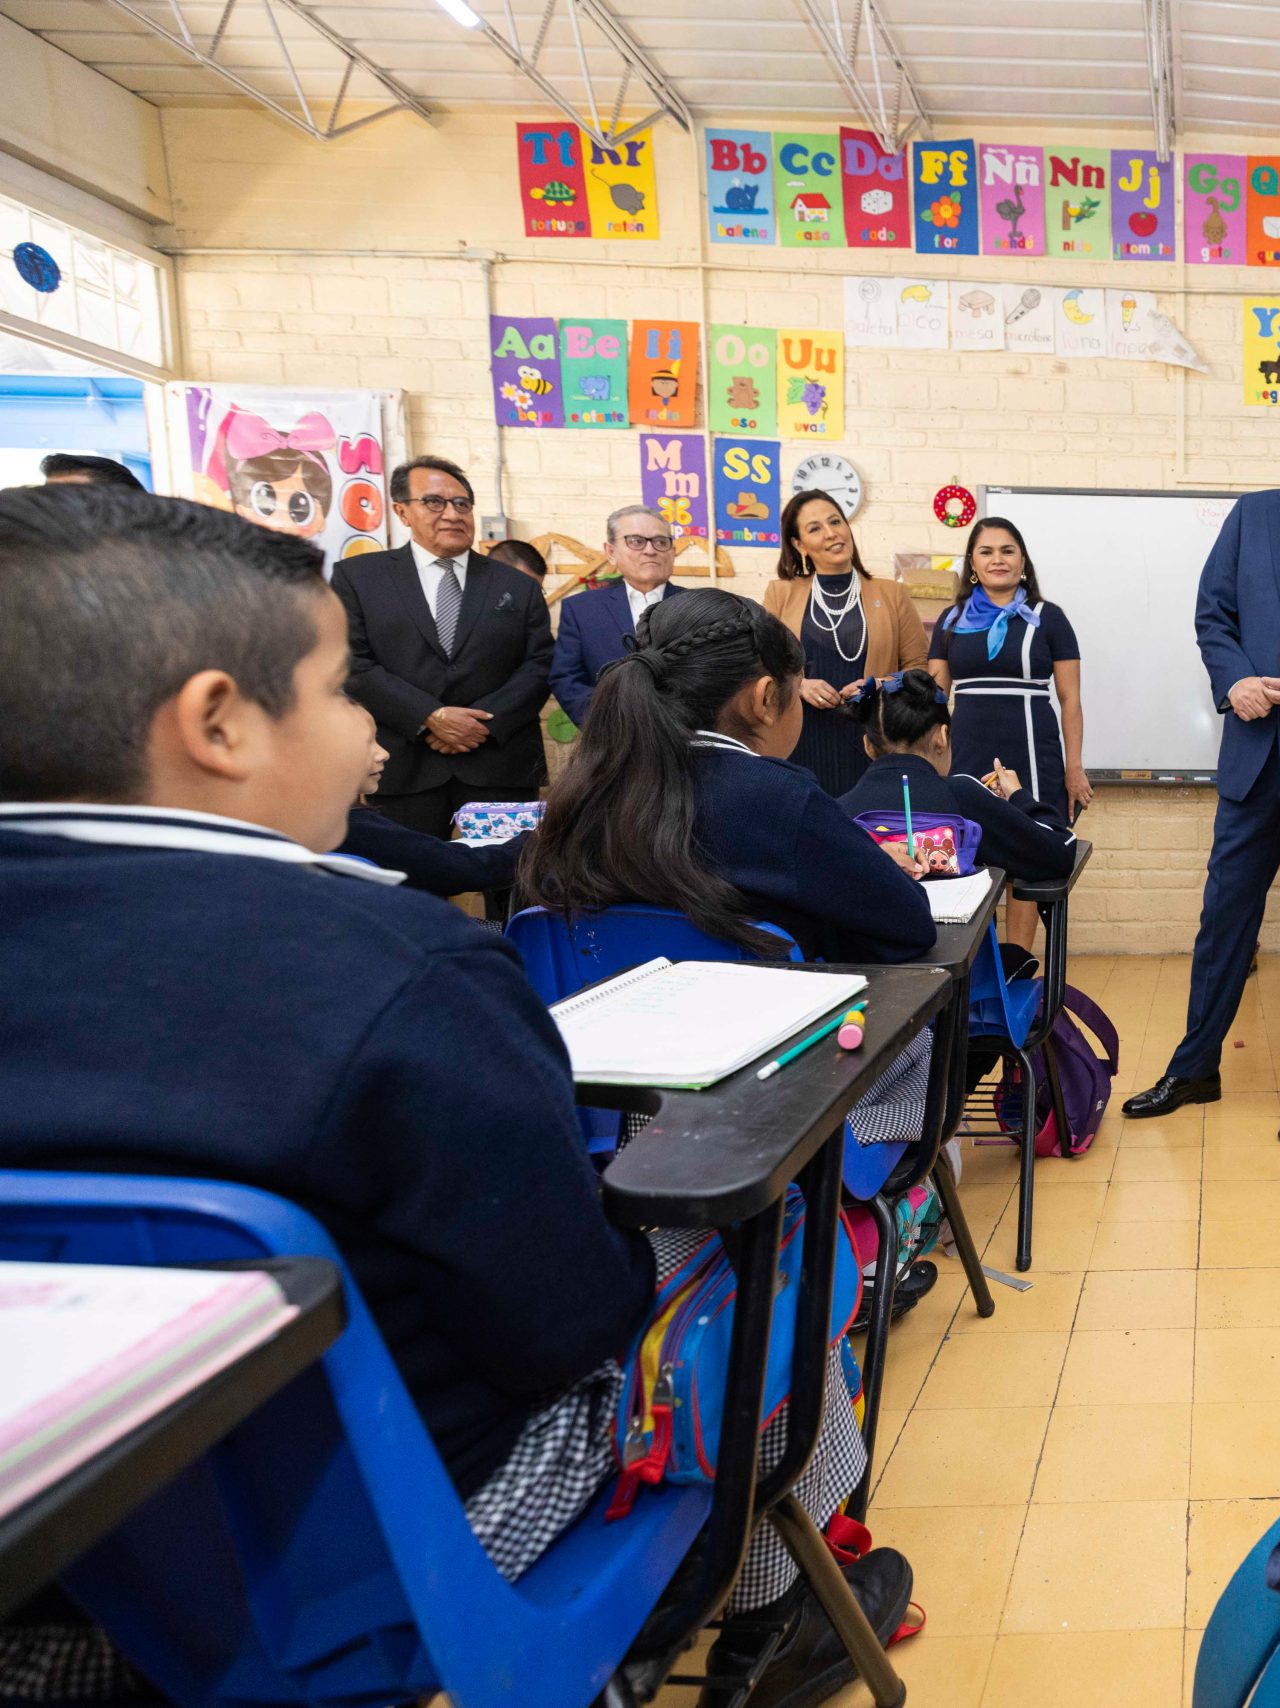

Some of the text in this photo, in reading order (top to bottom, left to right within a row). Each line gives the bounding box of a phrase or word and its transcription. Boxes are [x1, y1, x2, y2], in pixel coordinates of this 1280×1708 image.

[523, 130, 576, 167] Tt
[709, 138, 767, 175] Bb
[779, 143, 835, 176] Cc
[843, 138, 905, 181] Dd
[982, 147, 1040, 186] Ññ
[920, 150, 968, 186] Ff
[1049, 156, 1105, 189] Nn
[1118, 159, 1160, 208] Jj
[1188, 163, 1241, 212] Gg
[531, 219, 585, 234] tortuga
[608, 218, 644, 233] ratón
[717, 223, 767, 239] ballena
[861, 226, 896, 241] dado
[795, 229, 830, 241] casa
[934, 234, 959, 249] flor
[1063, 238, 1092, 252] nido
[1113, 242, 1171, 260] jitomate
[1201, 247, 1231, 262] gato
[493, 326, 556, 361] Aa
[564, 326, 621, 359] Ee
[645, 329, 682, 360] Ii
[715, 335, 769, 368] Oo
[782, 338, 837, 374] Uu
[508, 407, 553, 428] abeja
[570, 409, 624, 424] elefante
[731, 418, 757, 429] oso
[795, 423, 826, 433] uvas
[722, 447, 771, 484] Ss
[807, 460, 817, 470] 11
[821, 456, 831, 467] 12
[836, 461, 842, 470] 1
[796, 469, 808, 480] 10
[844, 472, 854, 480] 2
[670, 524, 707, 540] iposa
[717, 527, 779, 543] sombrero
